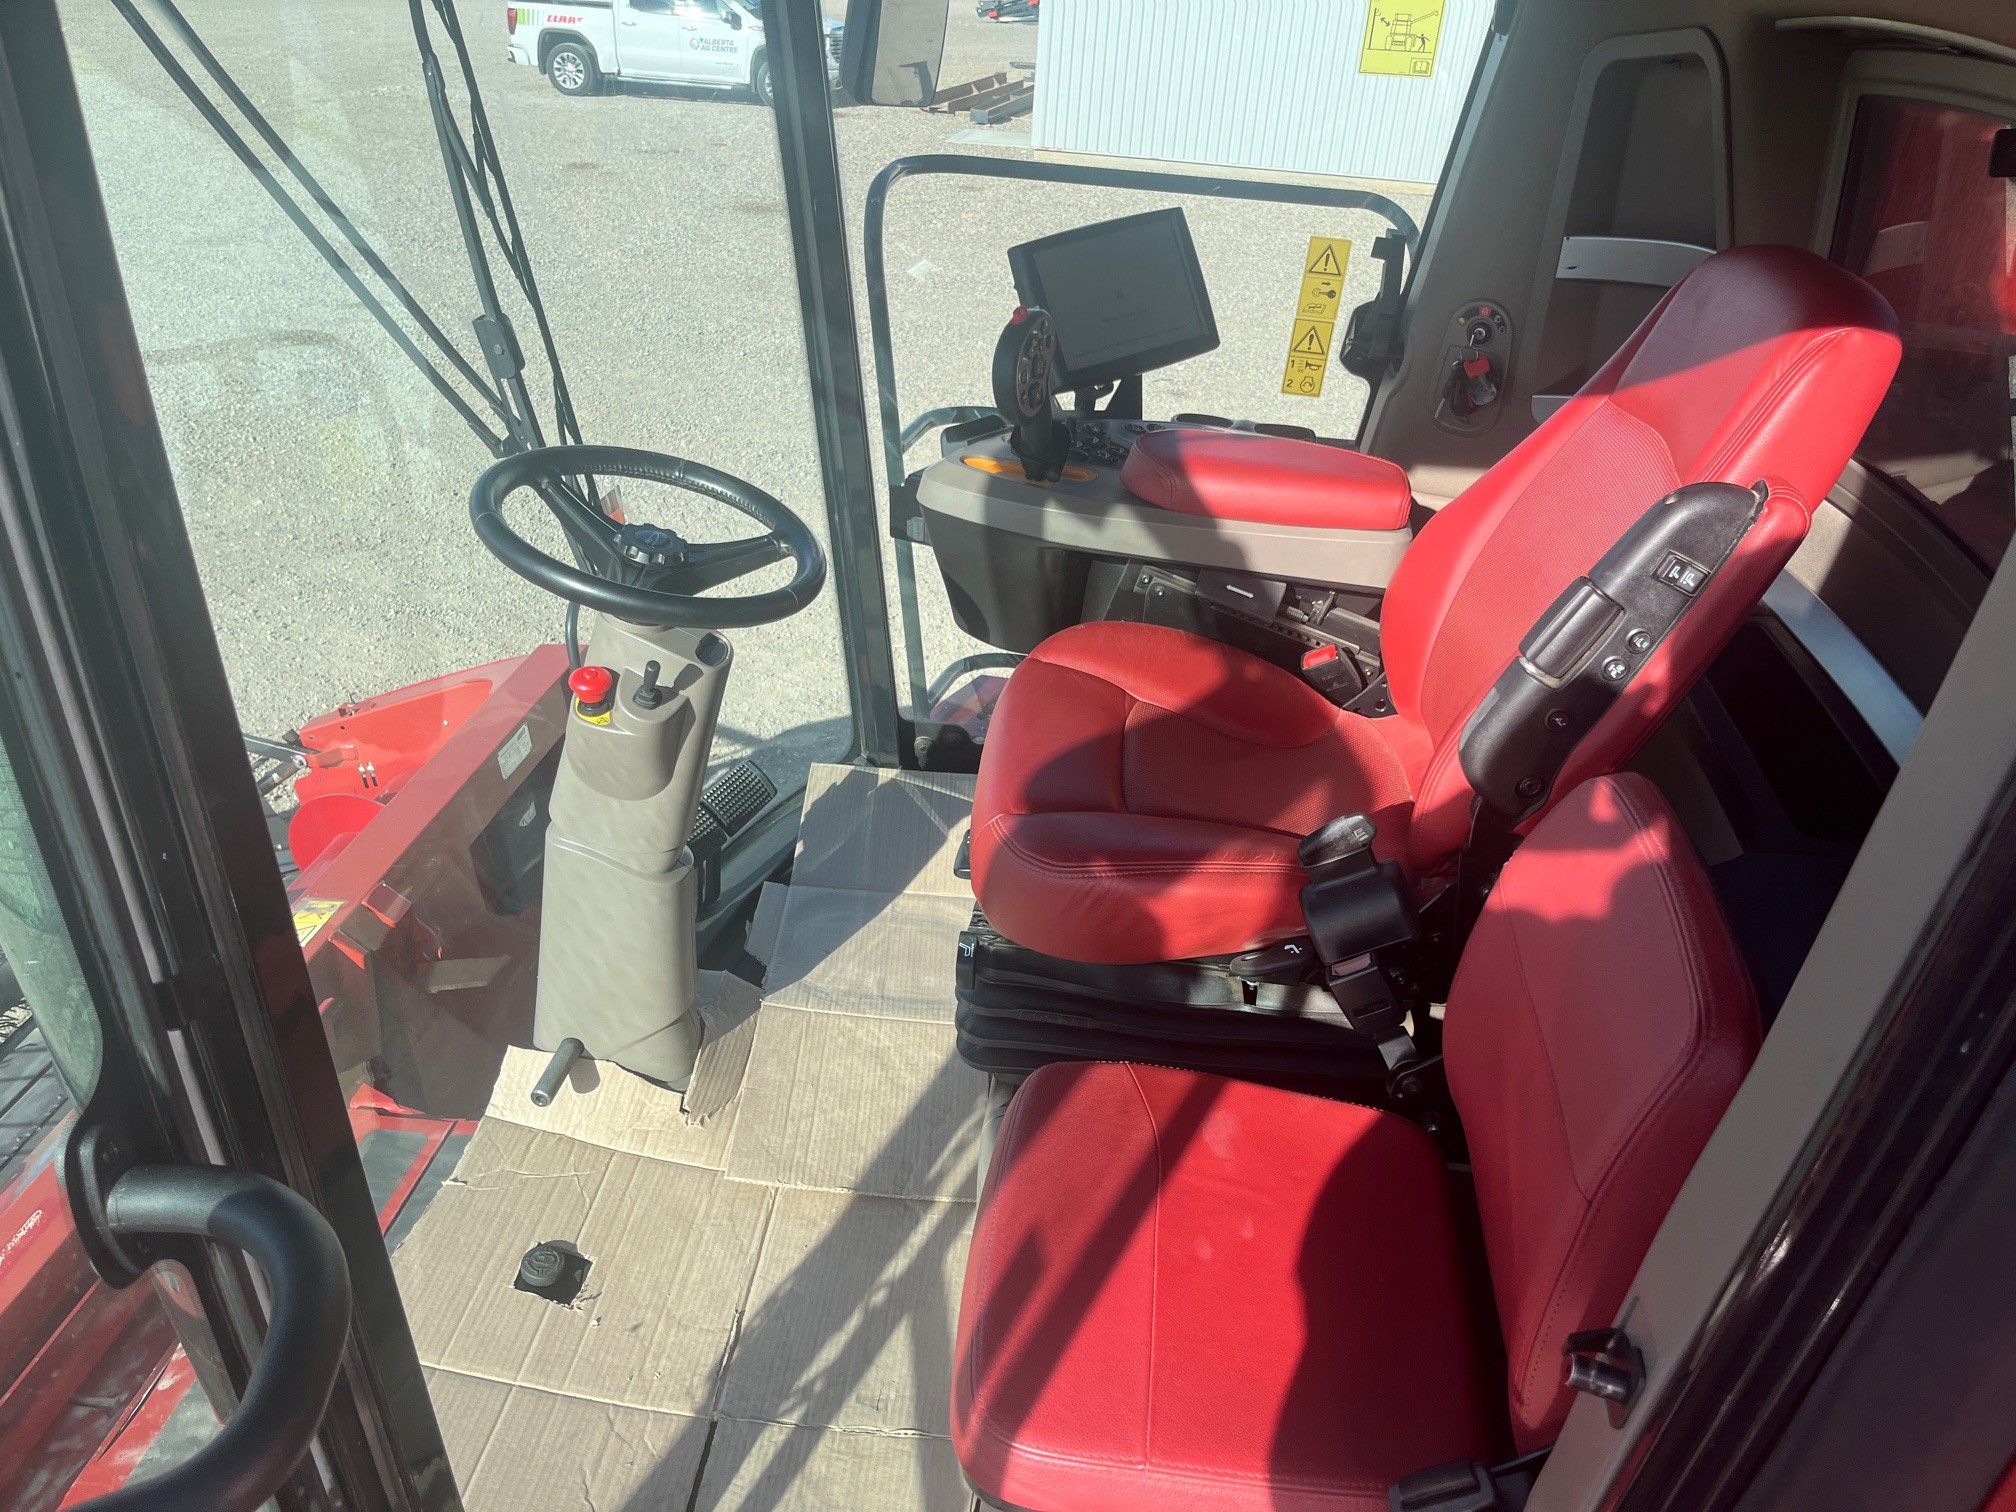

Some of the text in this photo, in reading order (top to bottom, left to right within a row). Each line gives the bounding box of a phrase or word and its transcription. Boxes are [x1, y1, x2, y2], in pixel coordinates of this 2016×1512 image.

[703, 38, 734, 46] ALBERTA
[711, 45, 738, 53] CENTRE
[1290, 359, 1295, 368] 1
[1286, 379, 1294, 388] 2
